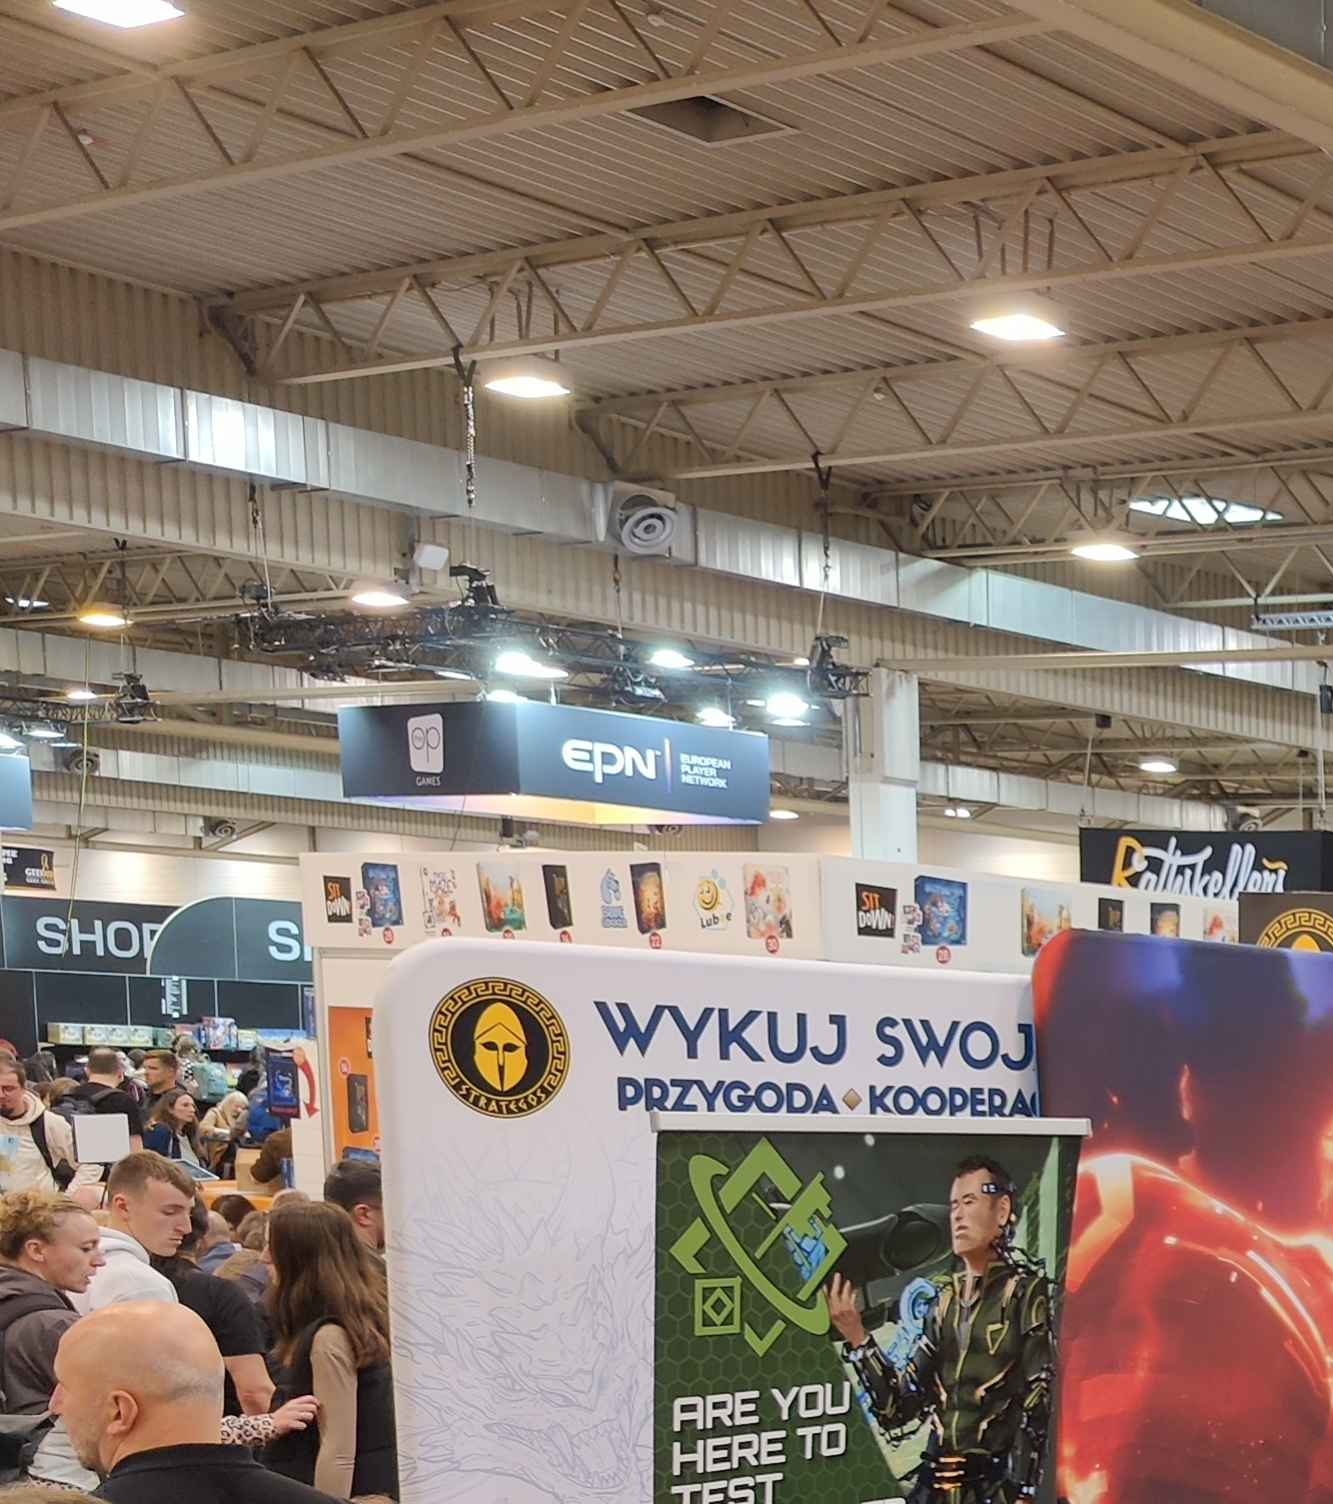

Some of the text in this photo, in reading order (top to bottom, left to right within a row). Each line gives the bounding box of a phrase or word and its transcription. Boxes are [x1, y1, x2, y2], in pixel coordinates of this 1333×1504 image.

[562, 739, 657, 783] EPN
[680, 753, 731, 770] EUROPEAN
[680, 764, 717, 777] PLAYER
[416, 776, 441, 787] GAMES
[680, 773, 728, 789] NETWORK
[862, 891, 881, 911] SIT
[594, 1000, 847, 1065] WYKUJ
[459, 1084, 547, 1114] STRATEGOS
[617, 1076, 840, 1114] PRZYGODA
[672, 1381, 850, 1432] ARE YOU
[672, 1422, 848, 1476] HERE TO
